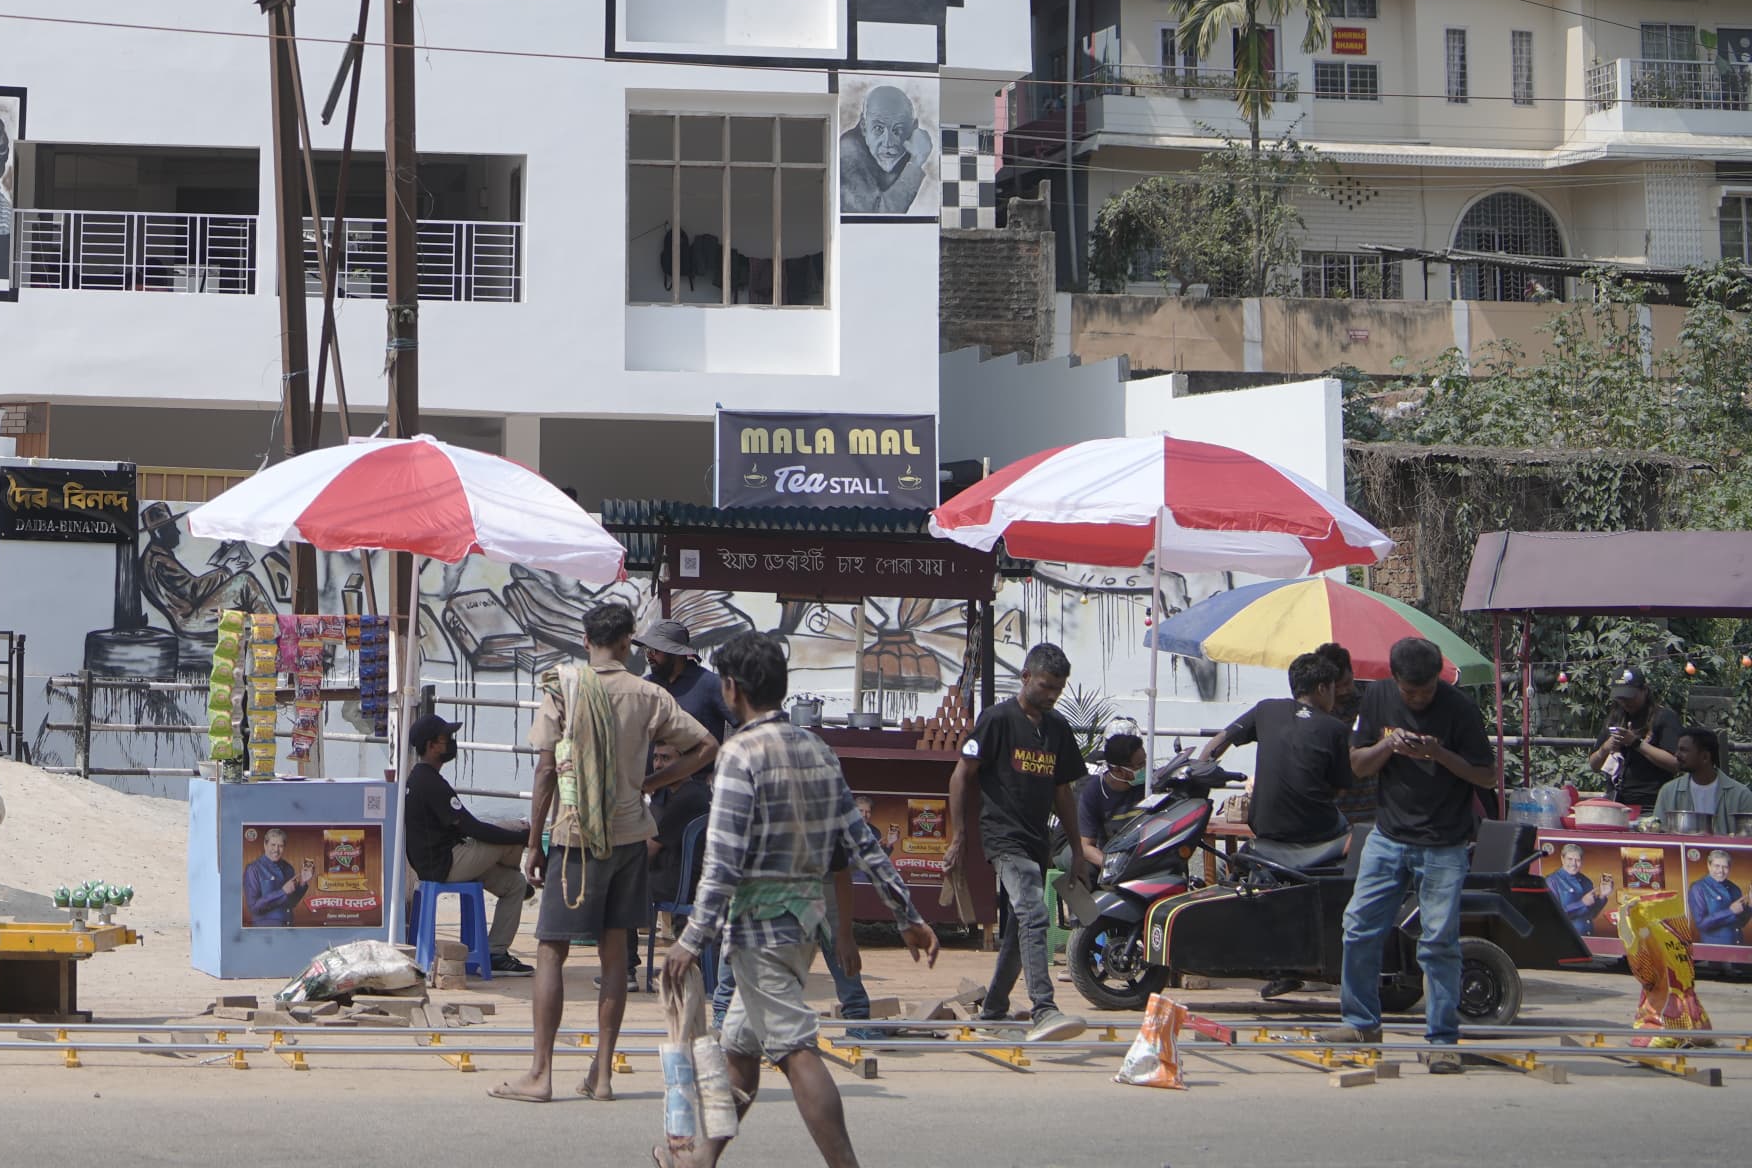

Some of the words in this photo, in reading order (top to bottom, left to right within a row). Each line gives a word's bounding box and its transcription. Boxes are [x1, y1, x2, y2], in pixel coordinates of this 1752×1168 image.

[740, 427, 835, 454] MALA
[848, 428, 921, 455] MAL
[773, 465, 829, 494] Tea
[829, 477, 889, 494] STALL
[15, 519, 117, 534] DAIBA-BINANDA
[895, 858, 926, 868] कमला
[310, 897, 344, 908] कमला
